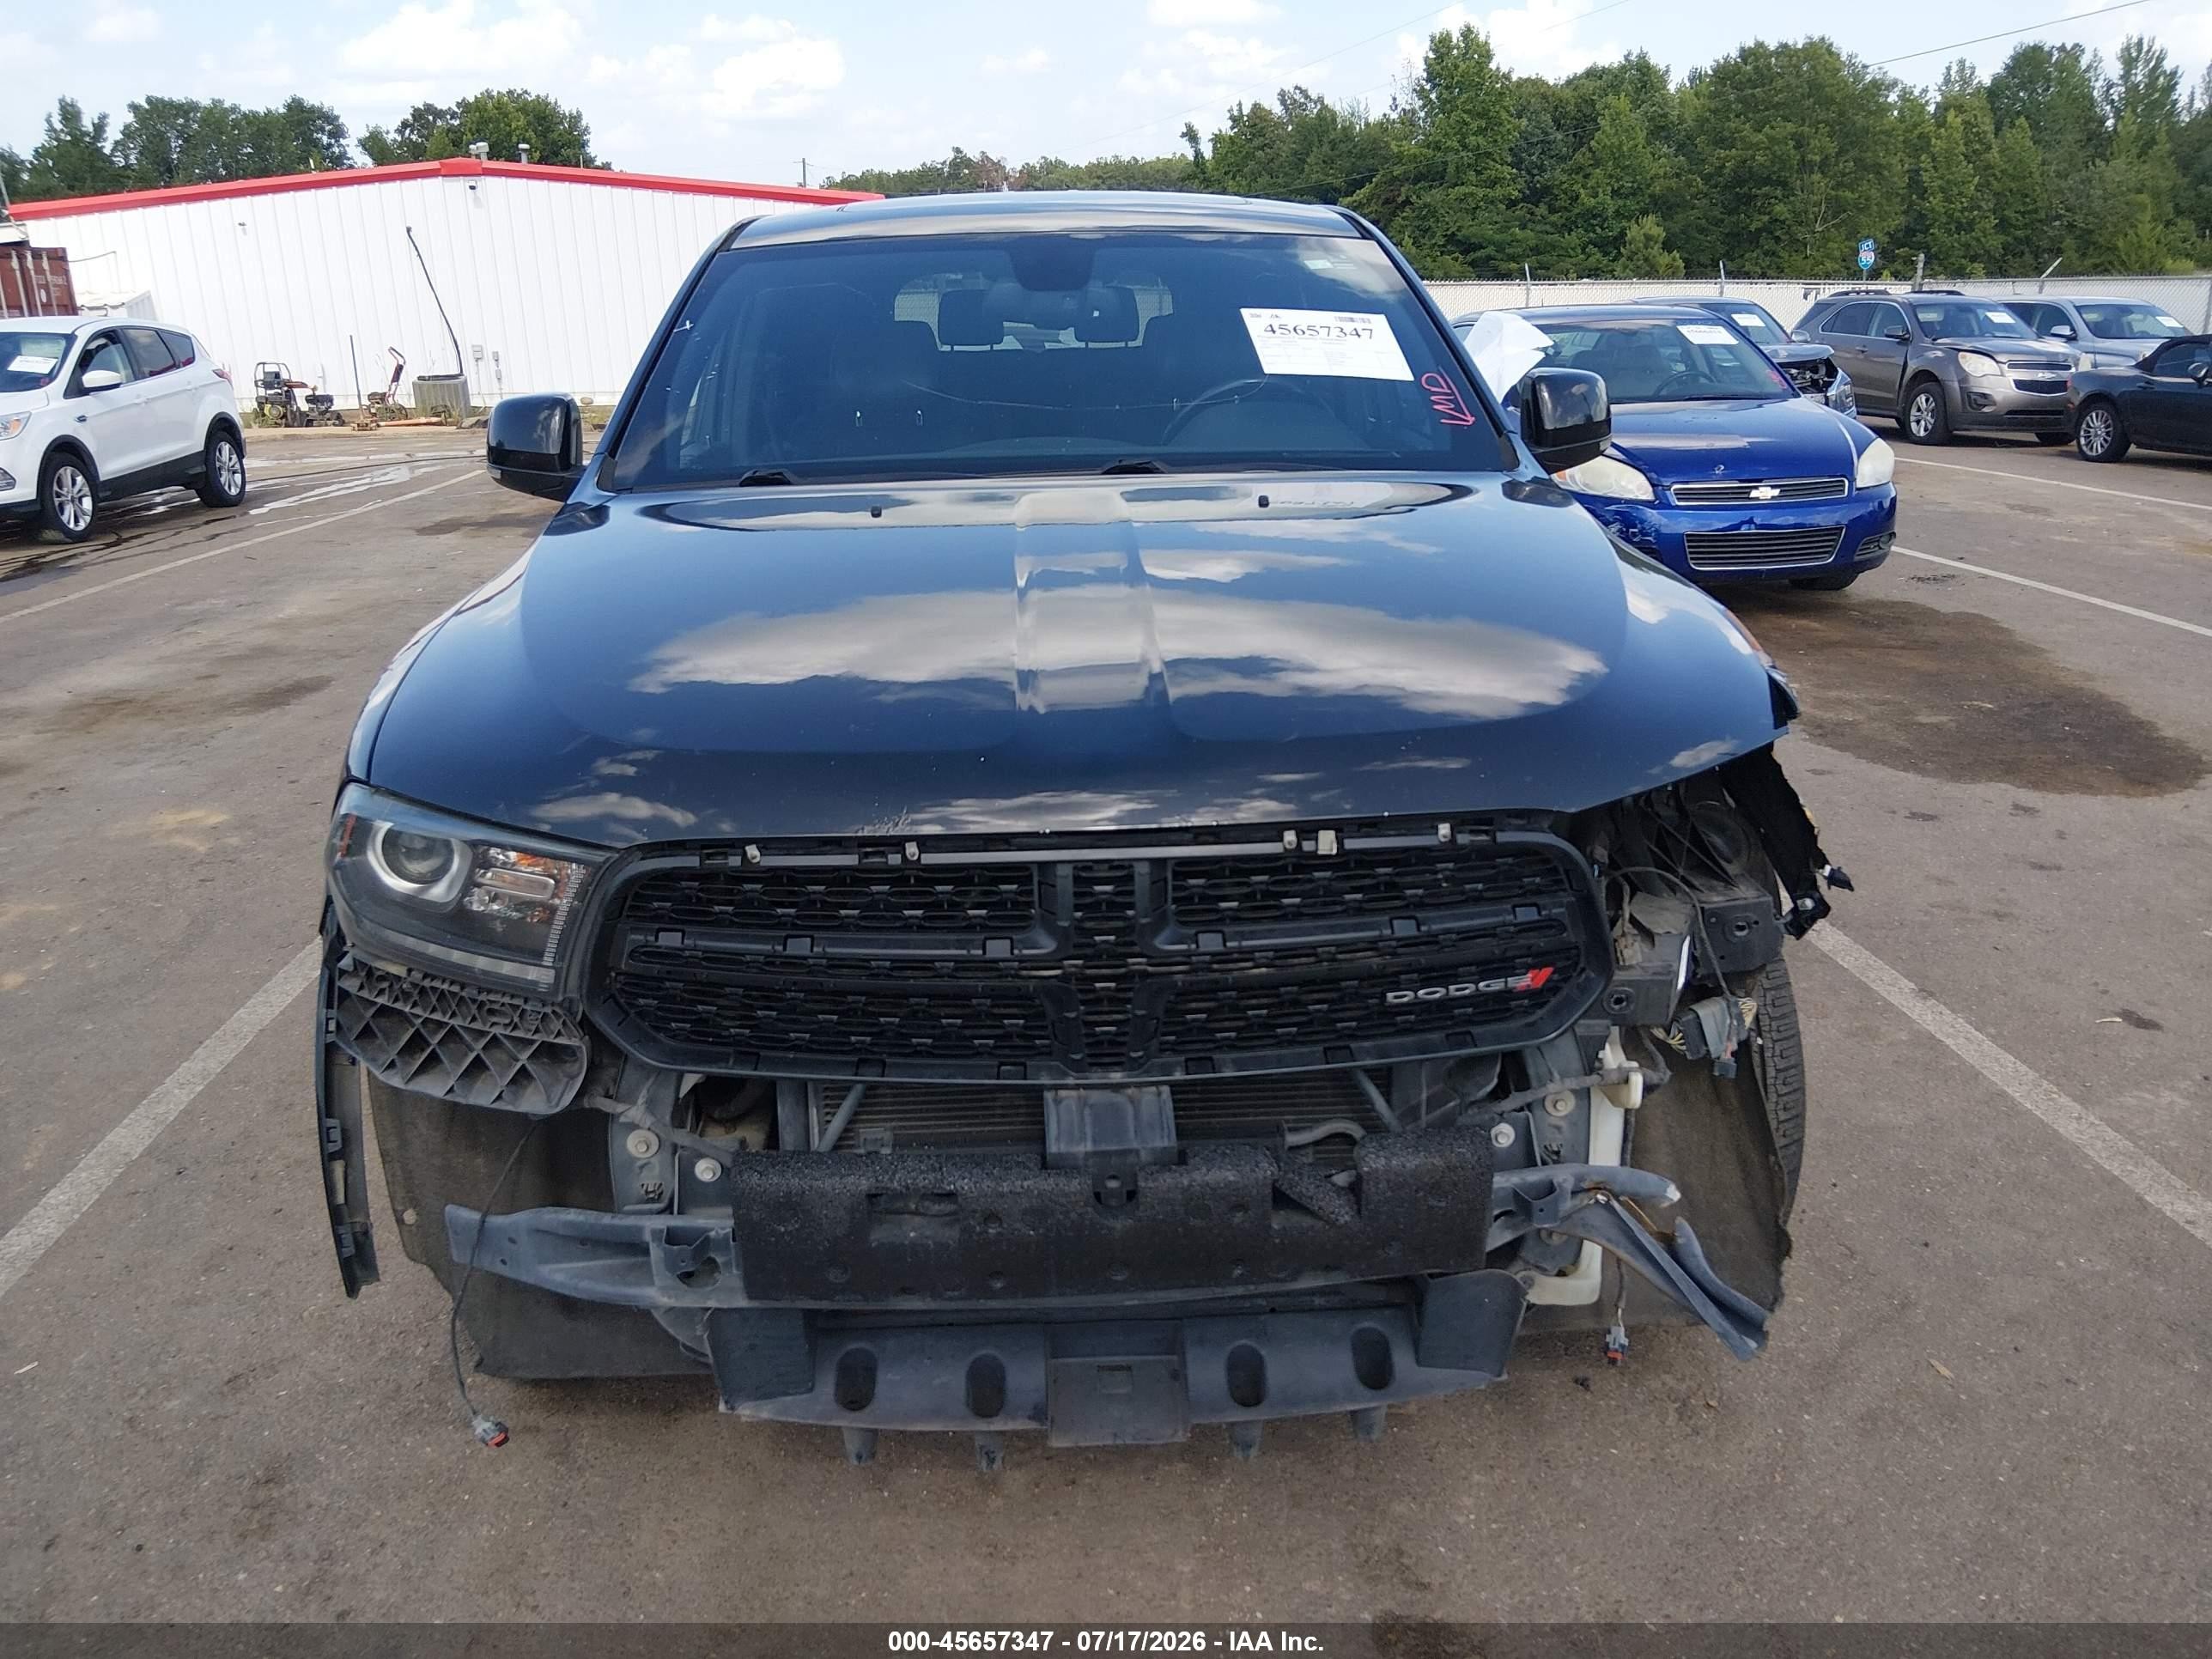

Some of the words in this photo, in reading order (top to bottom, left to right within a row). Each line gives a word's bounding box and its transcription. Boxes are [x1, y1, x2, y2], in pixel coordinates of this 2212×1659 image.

[1861, 241, 1872, 252] JCT
[1861, 256, 1871, 264] 55
[1264, 324, 1374, 340] 45657347
[1385, 974, 1533, 1005] DODGE
